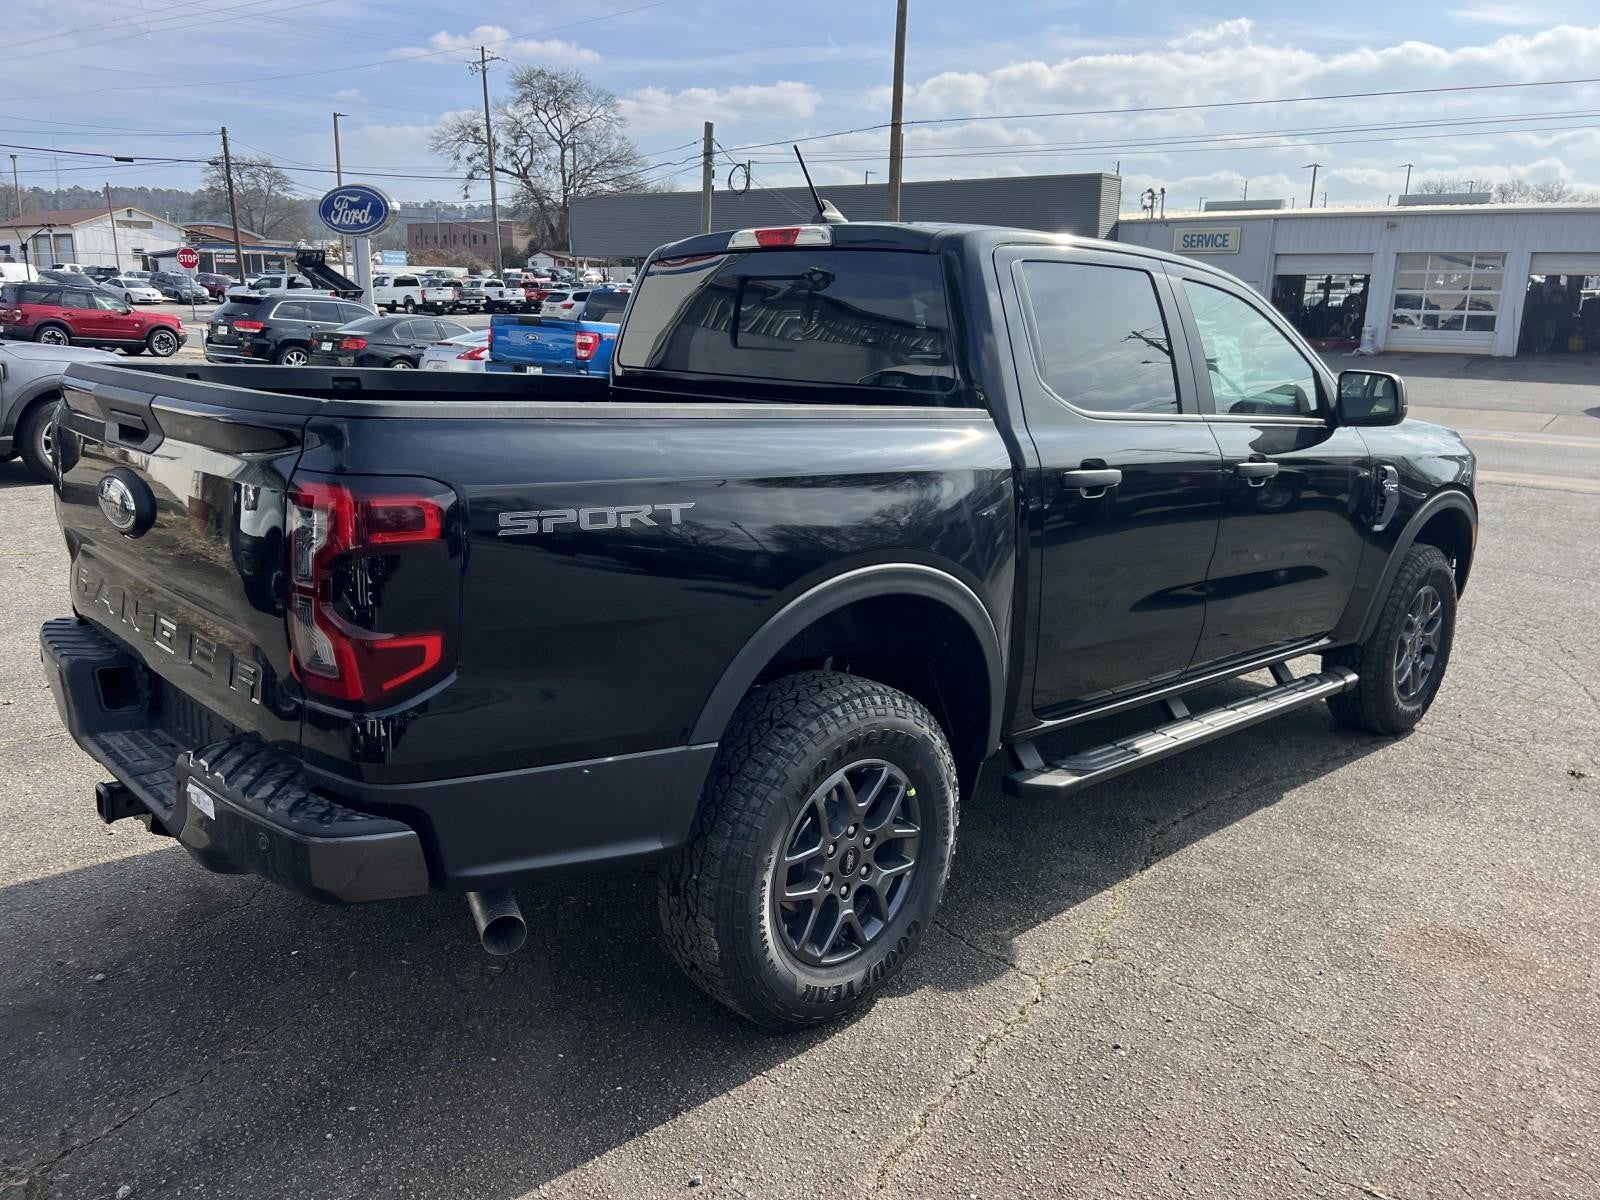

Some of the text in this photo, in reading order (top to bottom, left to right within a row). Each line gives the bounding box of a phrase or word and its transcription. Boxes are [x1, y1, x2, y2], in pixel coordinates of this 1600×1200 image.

[330, 195, 373, 225] Ford
[1182, 233, 1230, 248] SERVICE
[179, 254, 198, 263] STOP
[498, 503, 696, 536] SPORT
[76, 567, 263, 705] RANGER
[800, 919, 921, 1003] GOODYEAR
